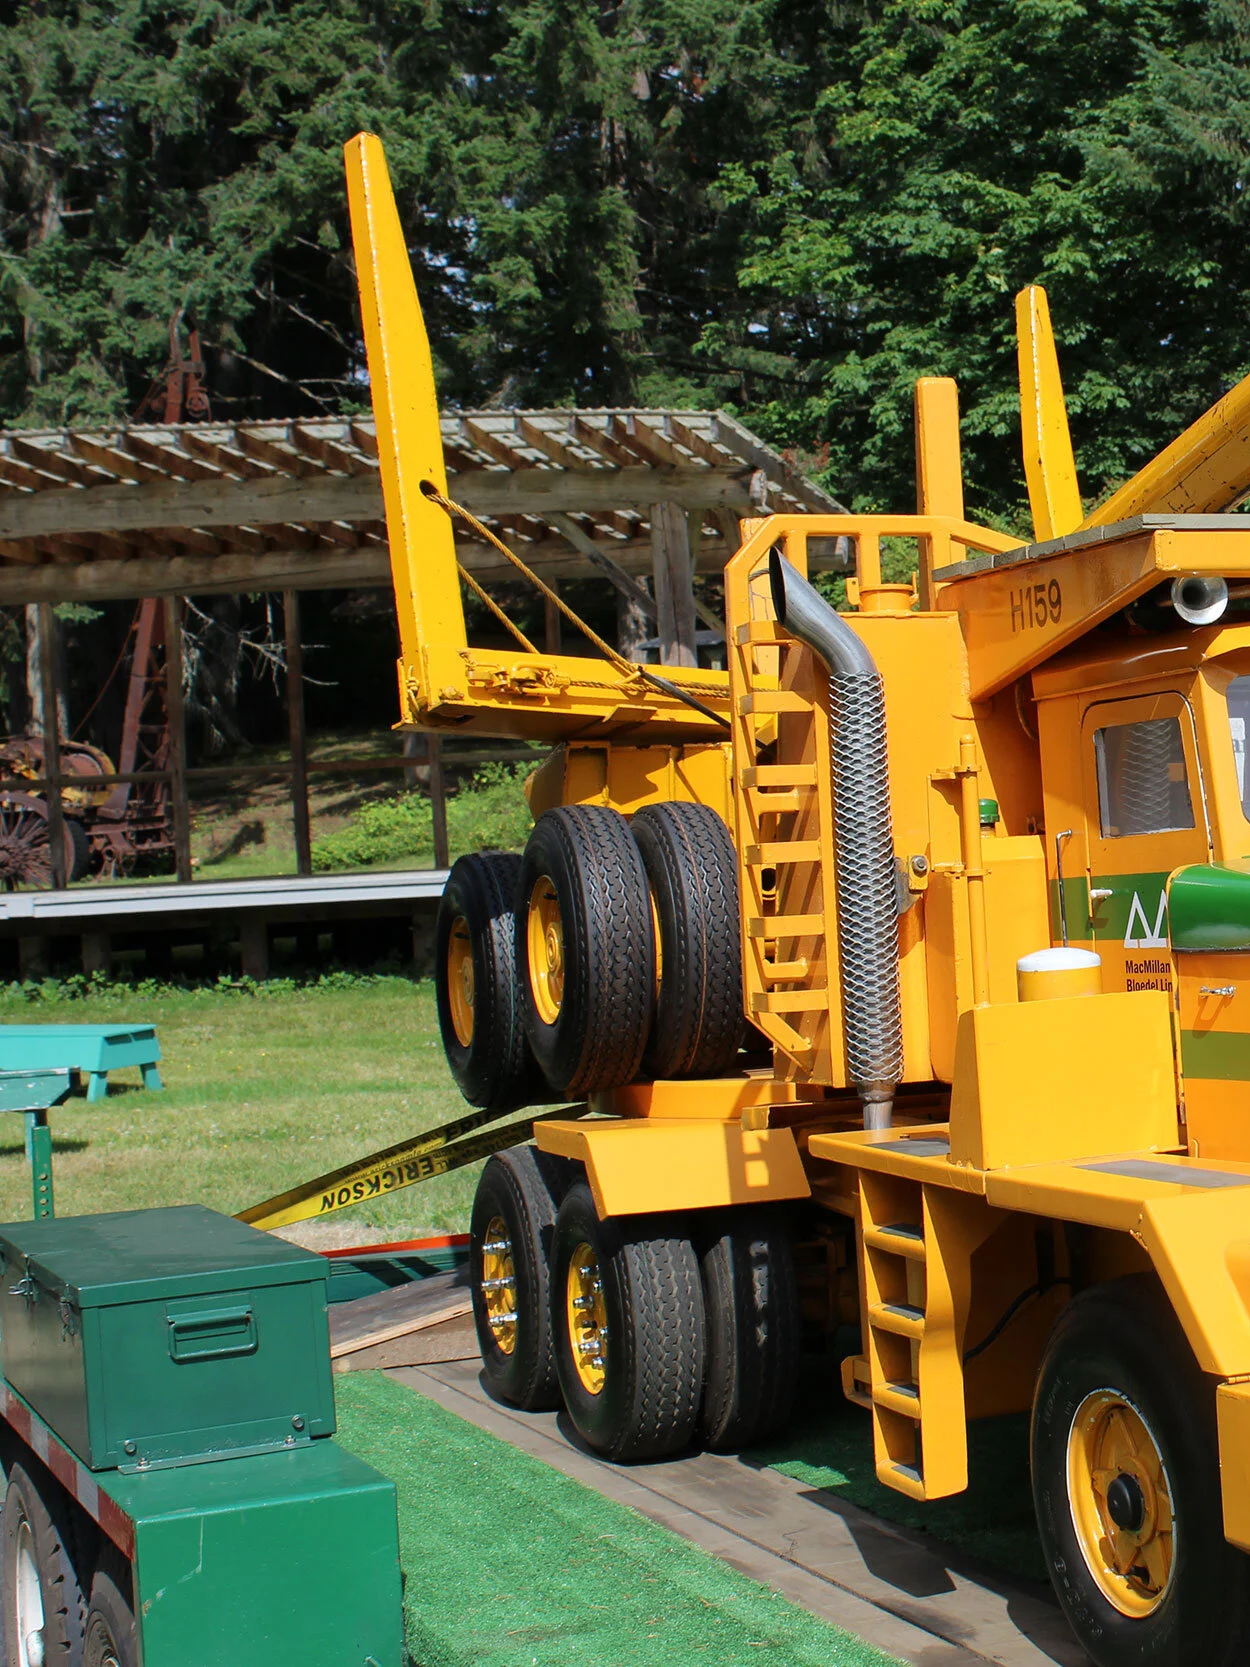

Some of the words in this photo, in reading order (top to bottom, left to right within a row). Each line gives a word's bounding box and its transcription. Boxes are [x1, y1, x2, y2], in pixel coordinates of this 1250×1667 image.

[1010, 578, 1061, 632] H159
[1125, 960, 1171, 974] MacMillan
[1126, 979, 1158, 992] Bloedel
[320, 1156, 435, 1212] ERICKSON
